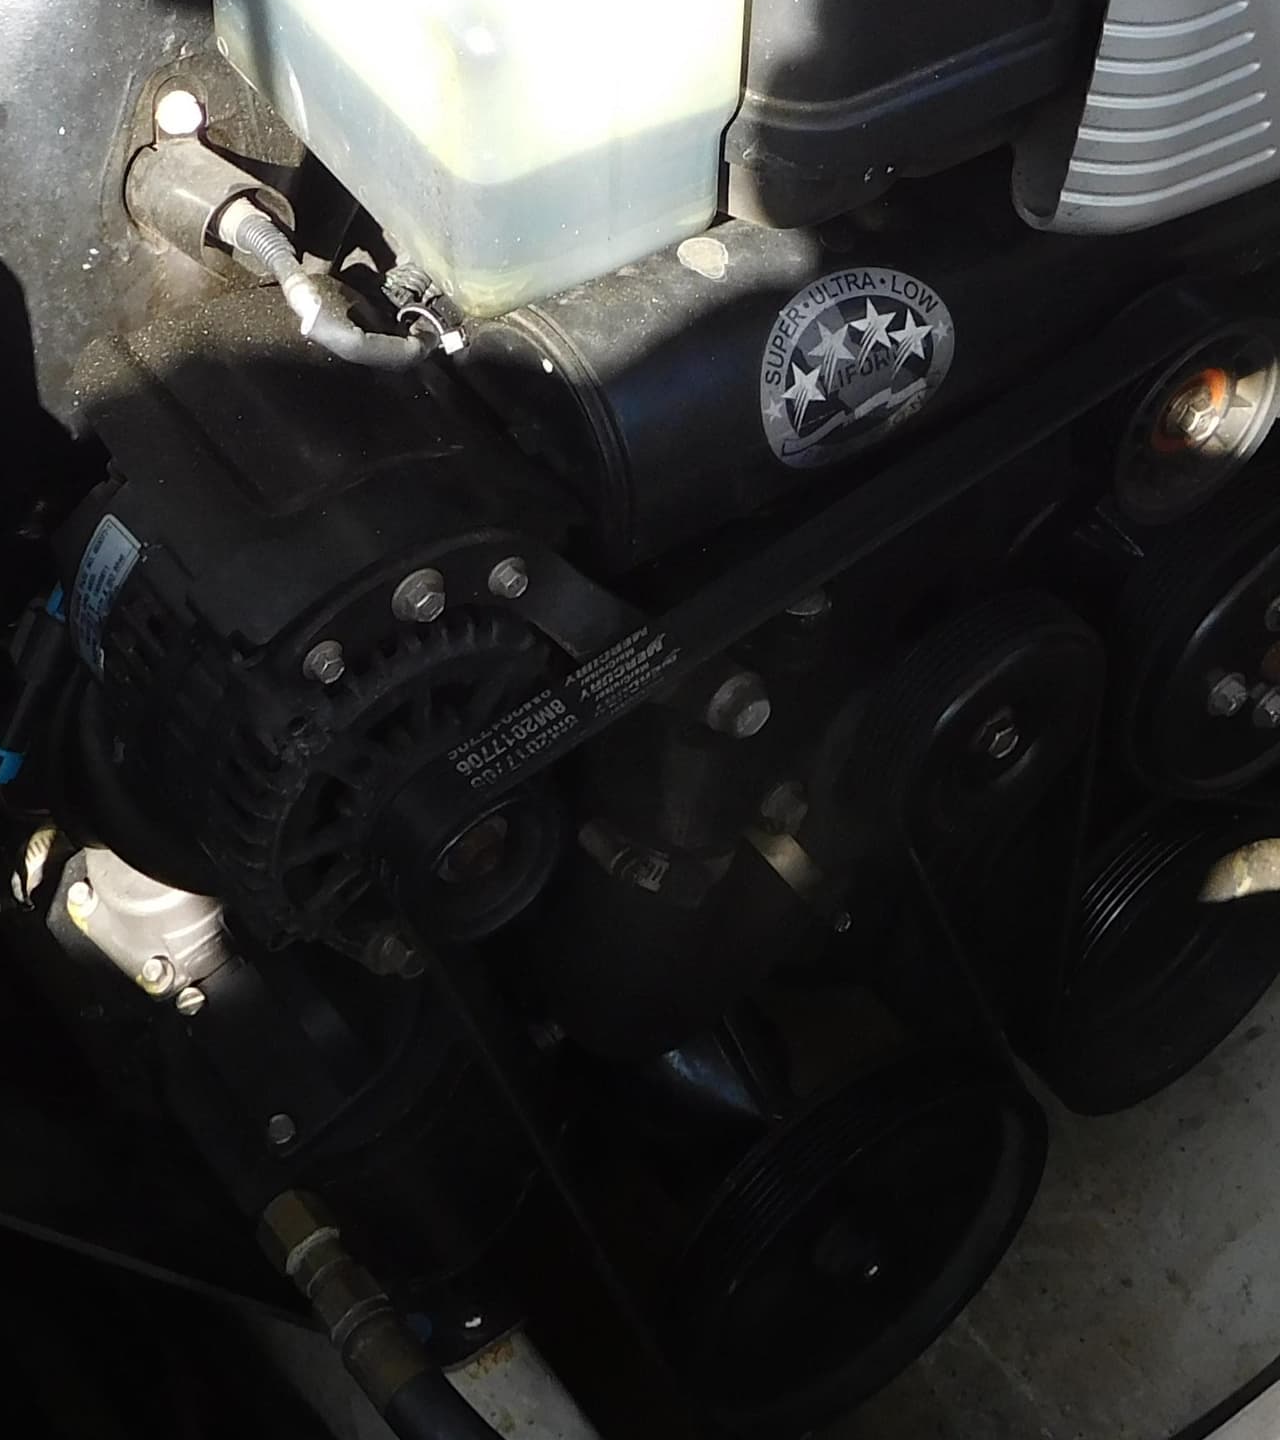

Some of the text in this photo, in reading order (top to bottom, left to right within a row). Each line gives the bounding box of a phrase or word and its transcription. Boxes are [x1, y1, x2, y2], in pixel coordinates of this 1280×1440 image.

[765, 307, 808, 386] SUPER
[807, 271, 877, 307] ULTRA
[890, 274, 940, 315] LOW
[455, 698, 567, 776] 8M2017706
